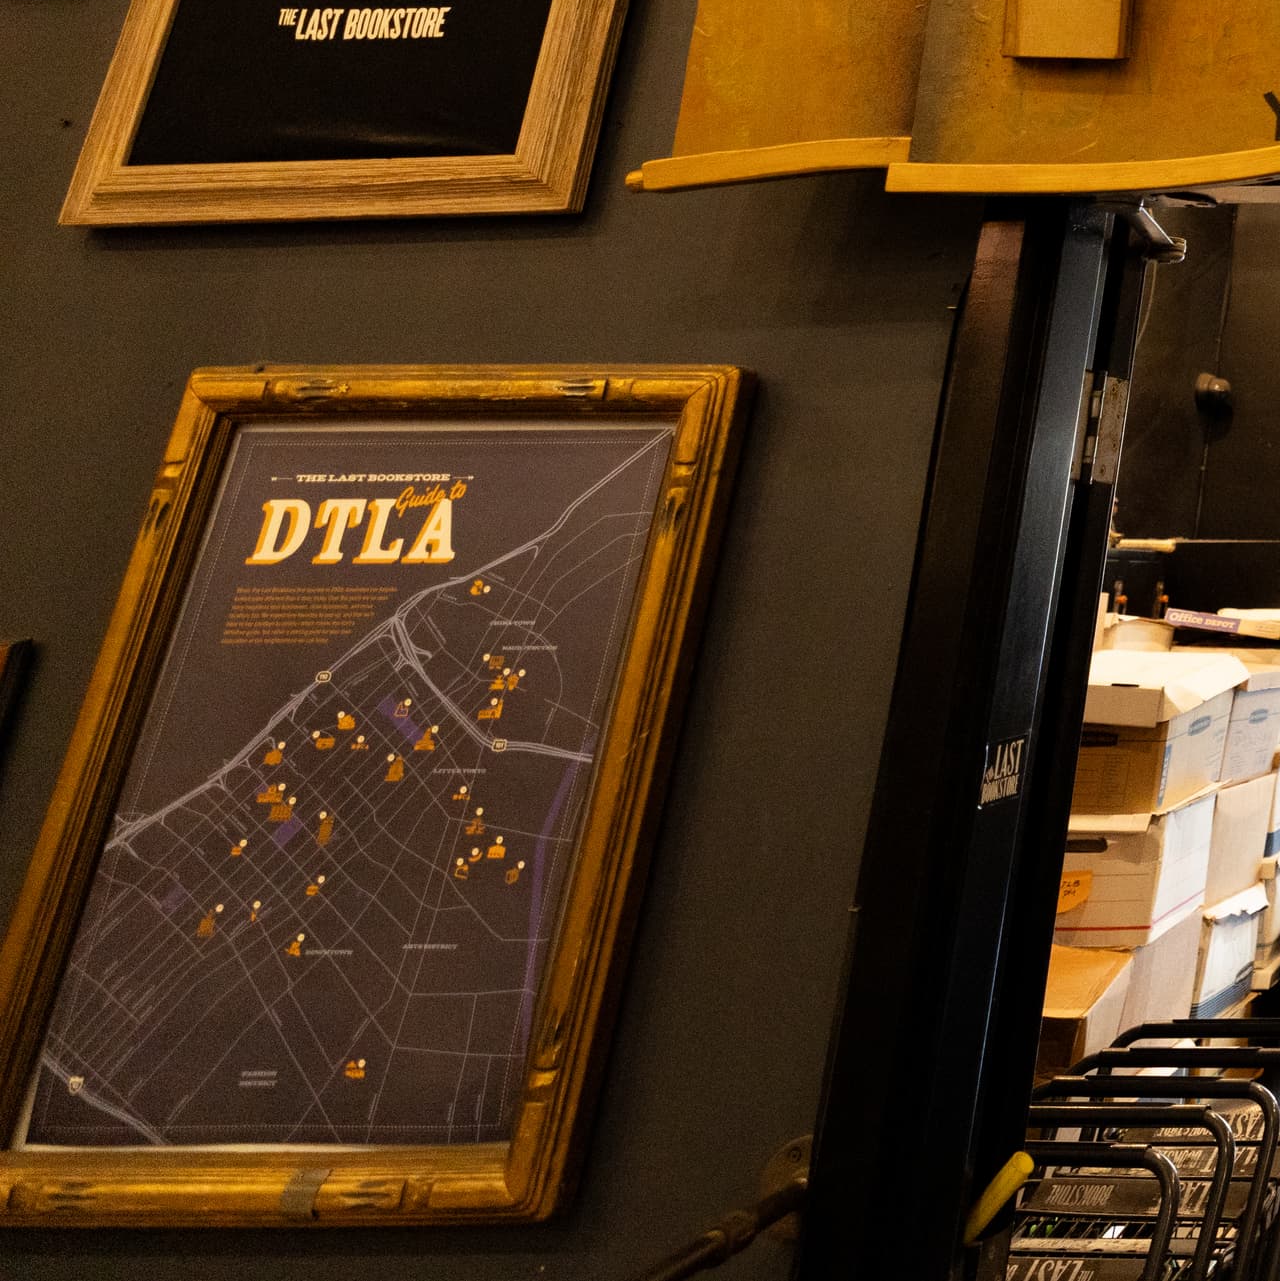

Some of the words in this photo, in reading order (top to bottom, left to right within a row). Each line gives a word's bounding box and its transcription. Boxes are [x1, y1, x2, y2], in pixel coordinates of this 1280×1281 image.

[278, 8, 300, 26] THE
[295, 8, 345, 41] LAST
[343, 6, 453, 40] BOOKSTORE
[296, 474, 326, 483] THE
[327, 474, 366, 483] LAST
[368, 473, 451, 483] BOOKSTORE
[396, 483, 446, 518] Guide
[450, 479, 468, 501] to
[244, 498, 456, 566] DTLA
[1169, 612, 1203, 626] Office
[993, 739, 1025, 780] LAST
[1045, 1183, 1115, 1207] BOOKSTORE
